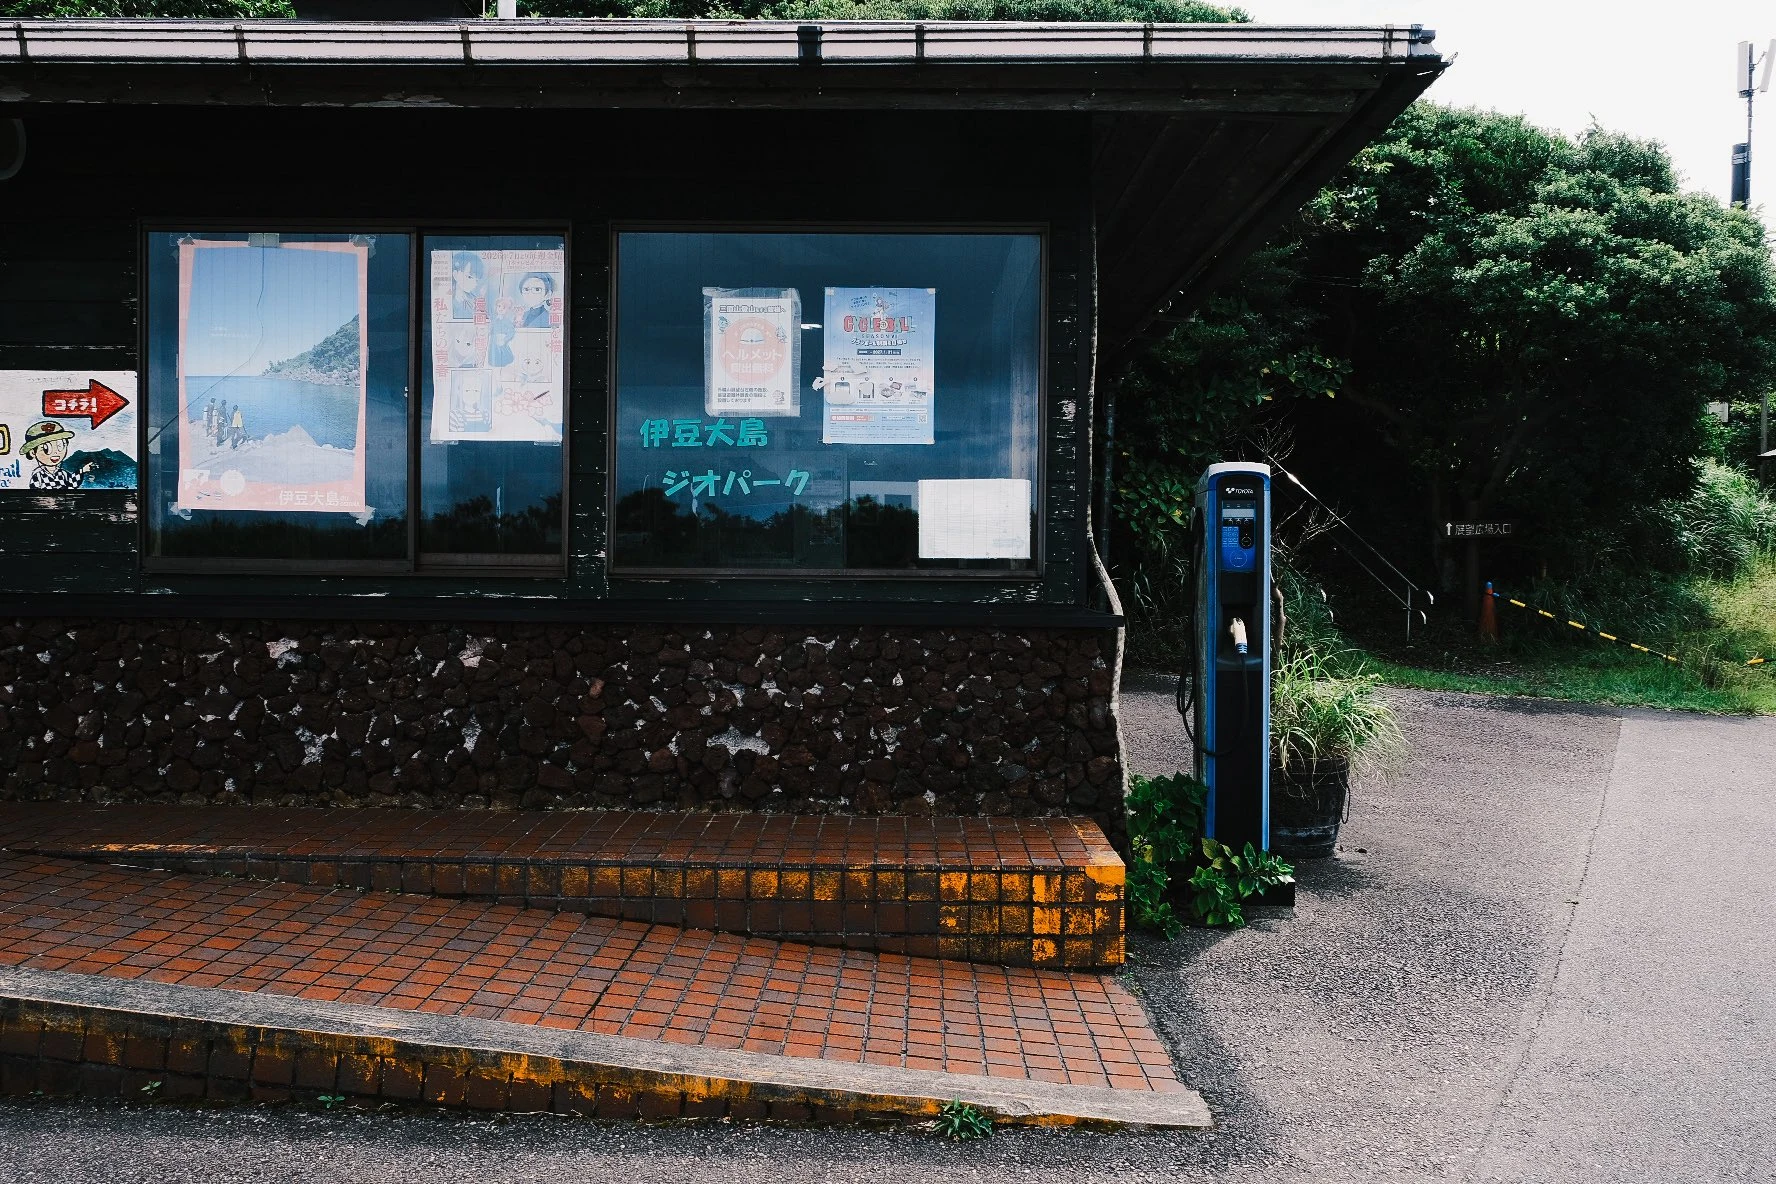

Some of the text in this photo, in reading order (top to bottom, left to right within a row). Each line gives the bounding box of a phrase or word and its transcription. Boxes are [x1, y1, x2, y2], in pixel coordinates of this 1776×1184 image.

[433, 297, 449, 378] 私たちの青春
[722, 348, 783, 361] ヘルメット
[53, 397, 98, 413] コチラ!
[640, 418, 768, 447] 伊豆大島
[662, 469, 810, 497] ジオパーク
[279, 490, 340, 506] 伊豆大島
[1454, 523, 1512, 536] 展望広場入口
